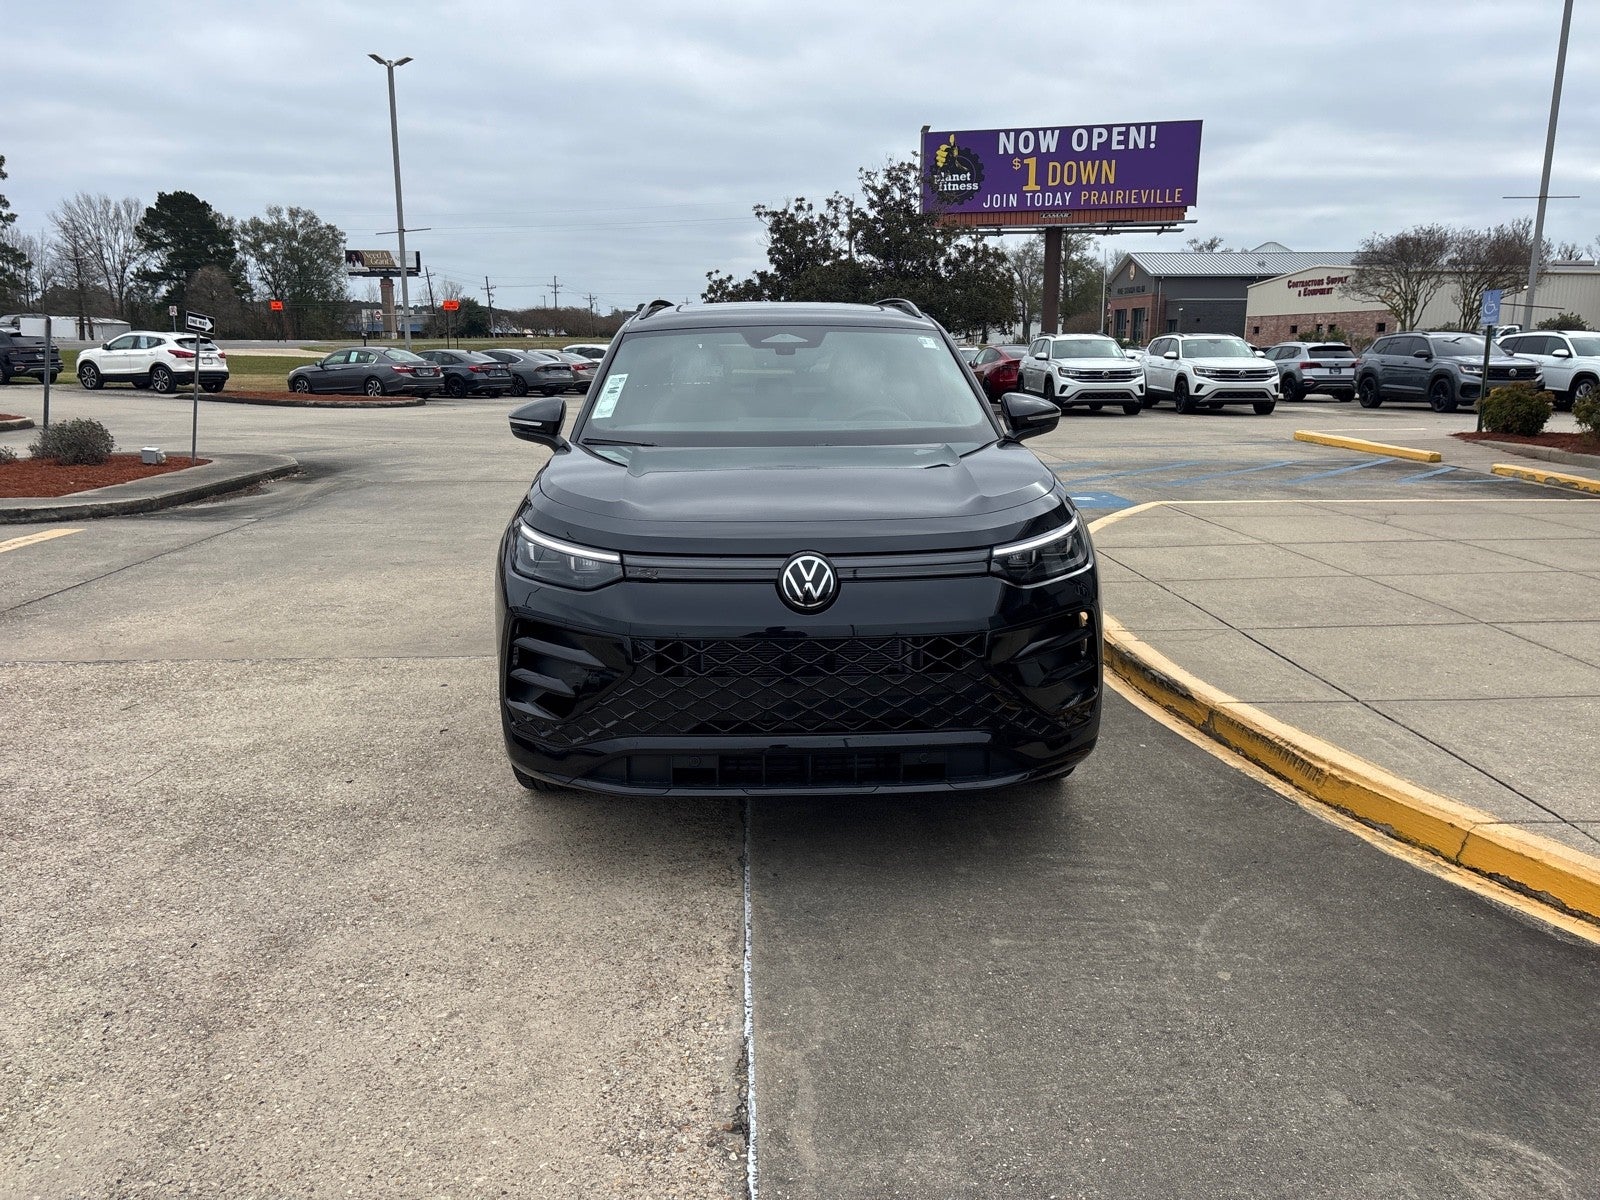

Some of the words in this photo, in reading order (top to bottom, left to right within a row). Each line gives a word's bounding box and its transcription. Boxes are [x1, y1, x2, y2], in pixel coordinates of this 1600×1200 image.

[998, 129, 1060, 155] NOW
[1071, 125, 1157, 152] OPEN!
[933, 171, 971, 185] planet
[1047, 159, 1116, 187] DOWN
[938, 181, 979, 191] fitness
[982, 193, 1018, 208] JOIN
[1025, 191, 1072, 207] TODAY
[1080, 188, 1183, 206] PRAIRIEVILLE
